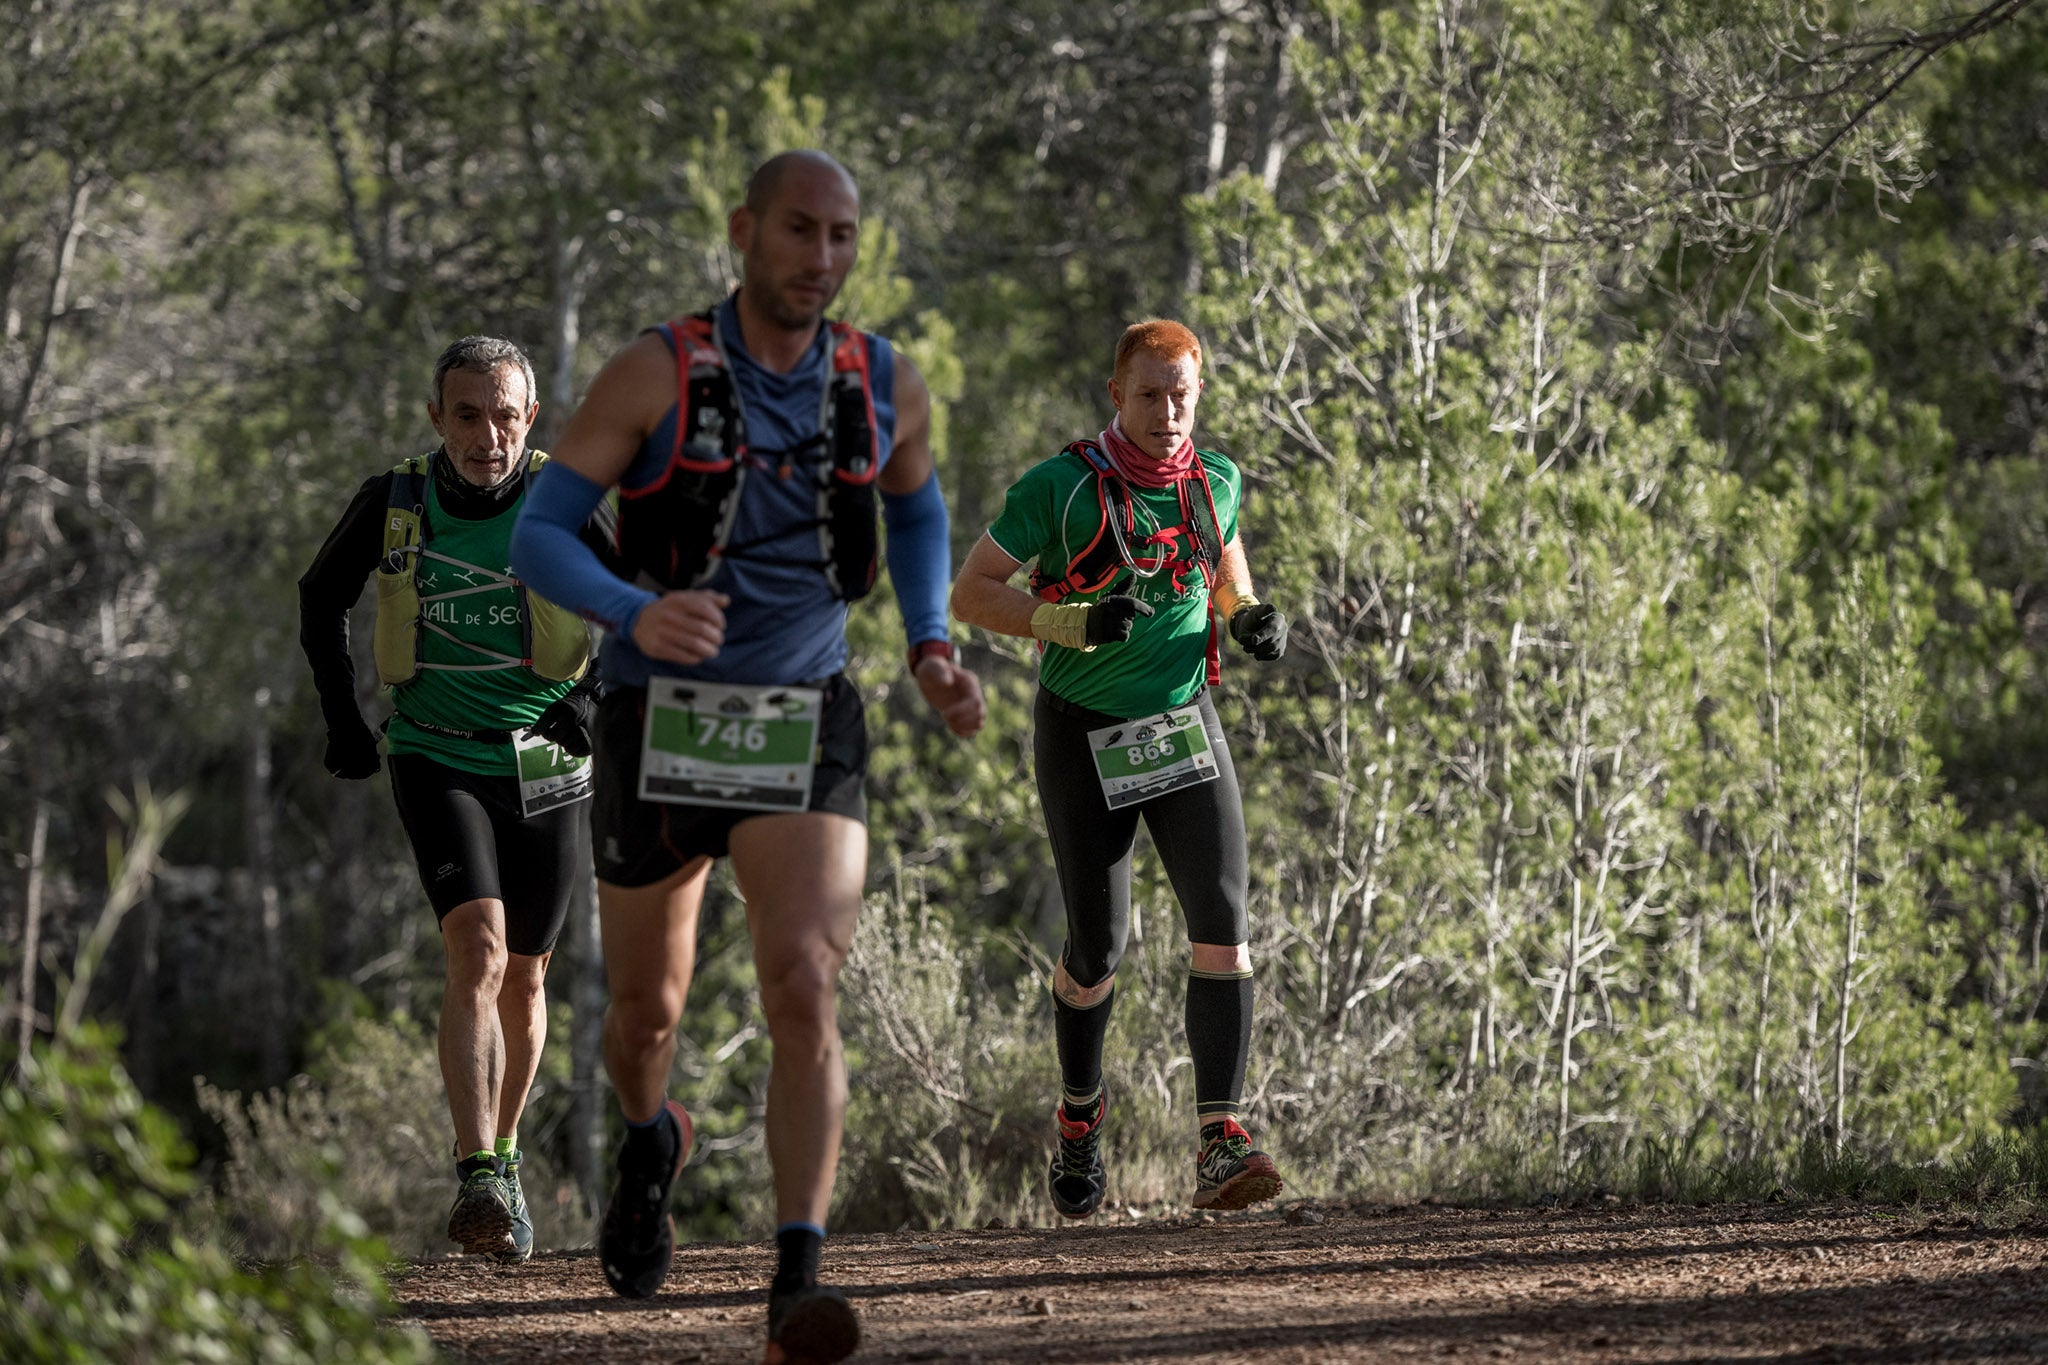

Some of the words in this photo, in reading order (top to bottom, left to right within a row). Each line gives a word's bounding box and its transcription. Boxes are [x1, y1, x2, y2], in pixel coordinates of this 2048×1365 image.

[1153, 592, 1168, 602] DE
[465, 614, 480, 625] DE
[696, 718, 767, 752] 746
[1127, 737, 1175, 766] 866
